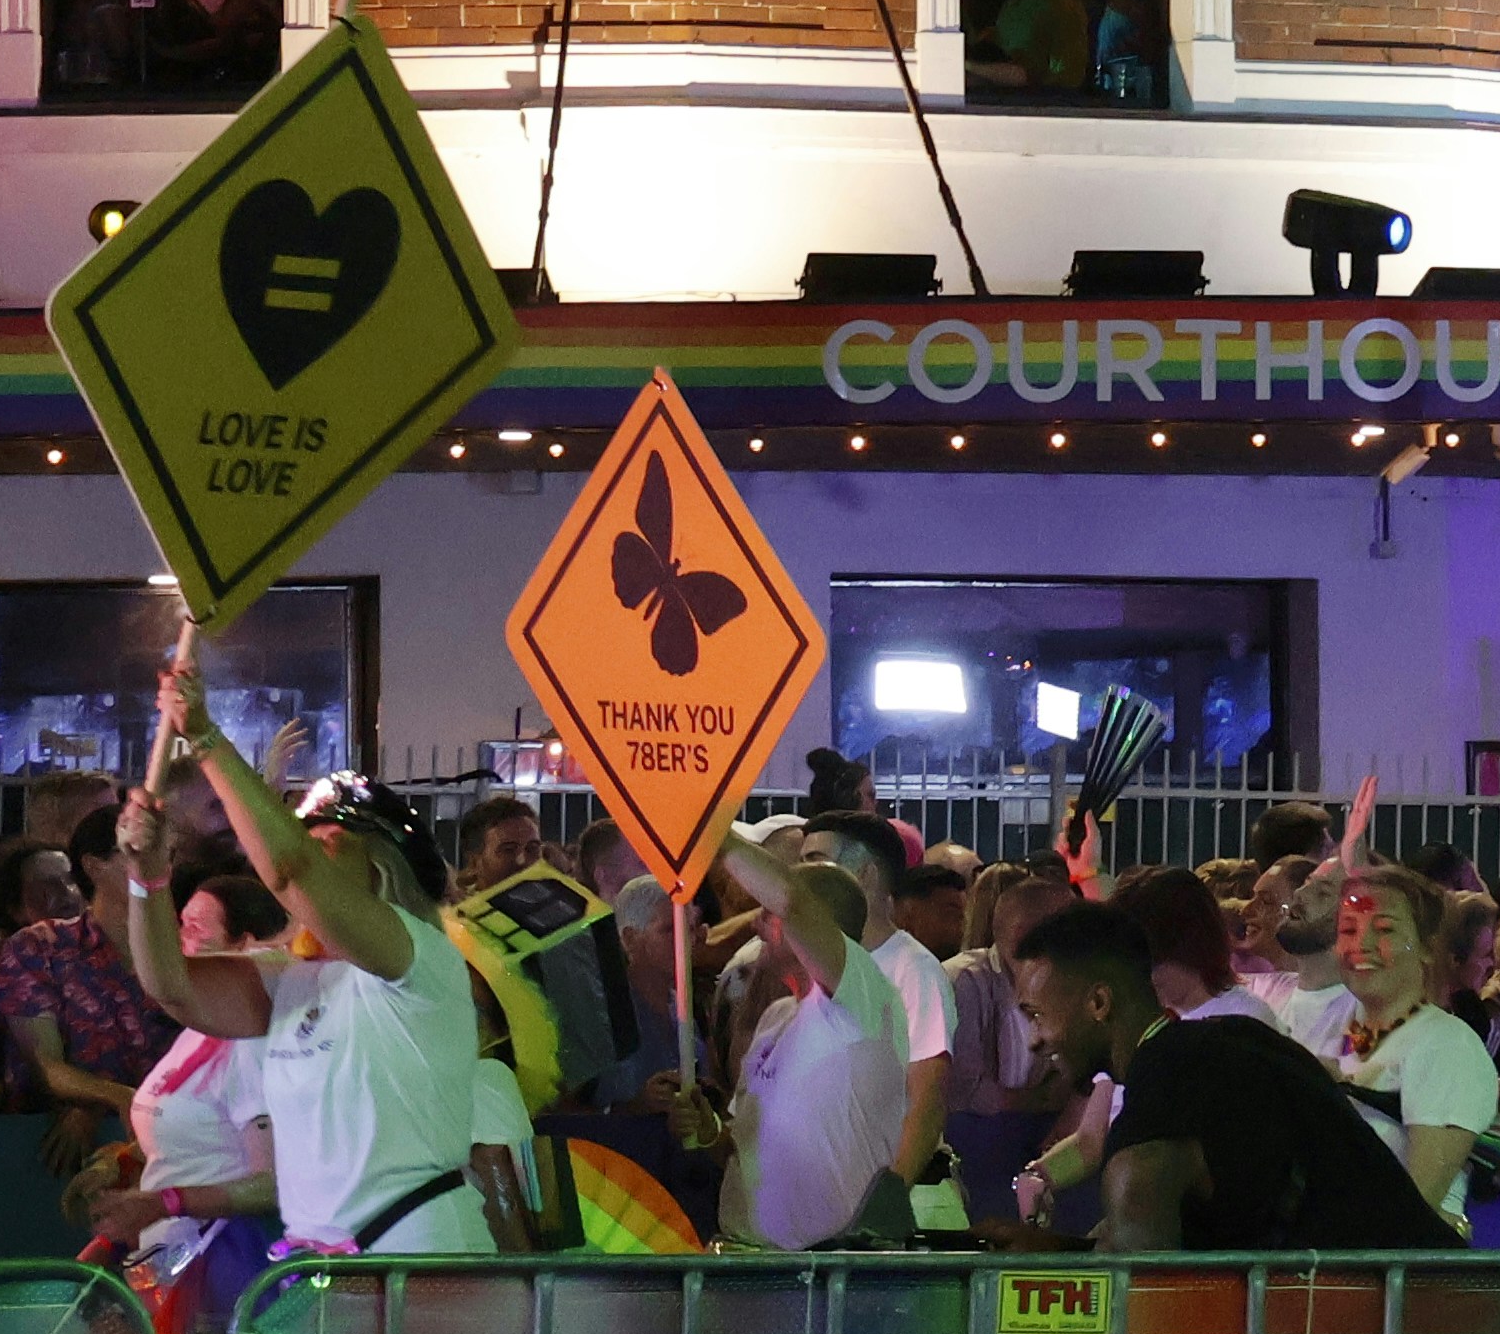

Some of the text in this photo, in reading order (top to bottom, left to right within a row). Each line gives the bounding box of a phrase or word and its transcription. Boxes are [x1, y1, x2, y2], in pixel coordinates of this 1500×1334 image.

[198, 409, 328, 453] LOVE IS
[207, 458, 298, 497] LOVE
[597, 700, 735, 736] THANK YOU
[626, 741, 710, 773] 78ER'S
[1012, 1279, 1091, 1315] TFH
